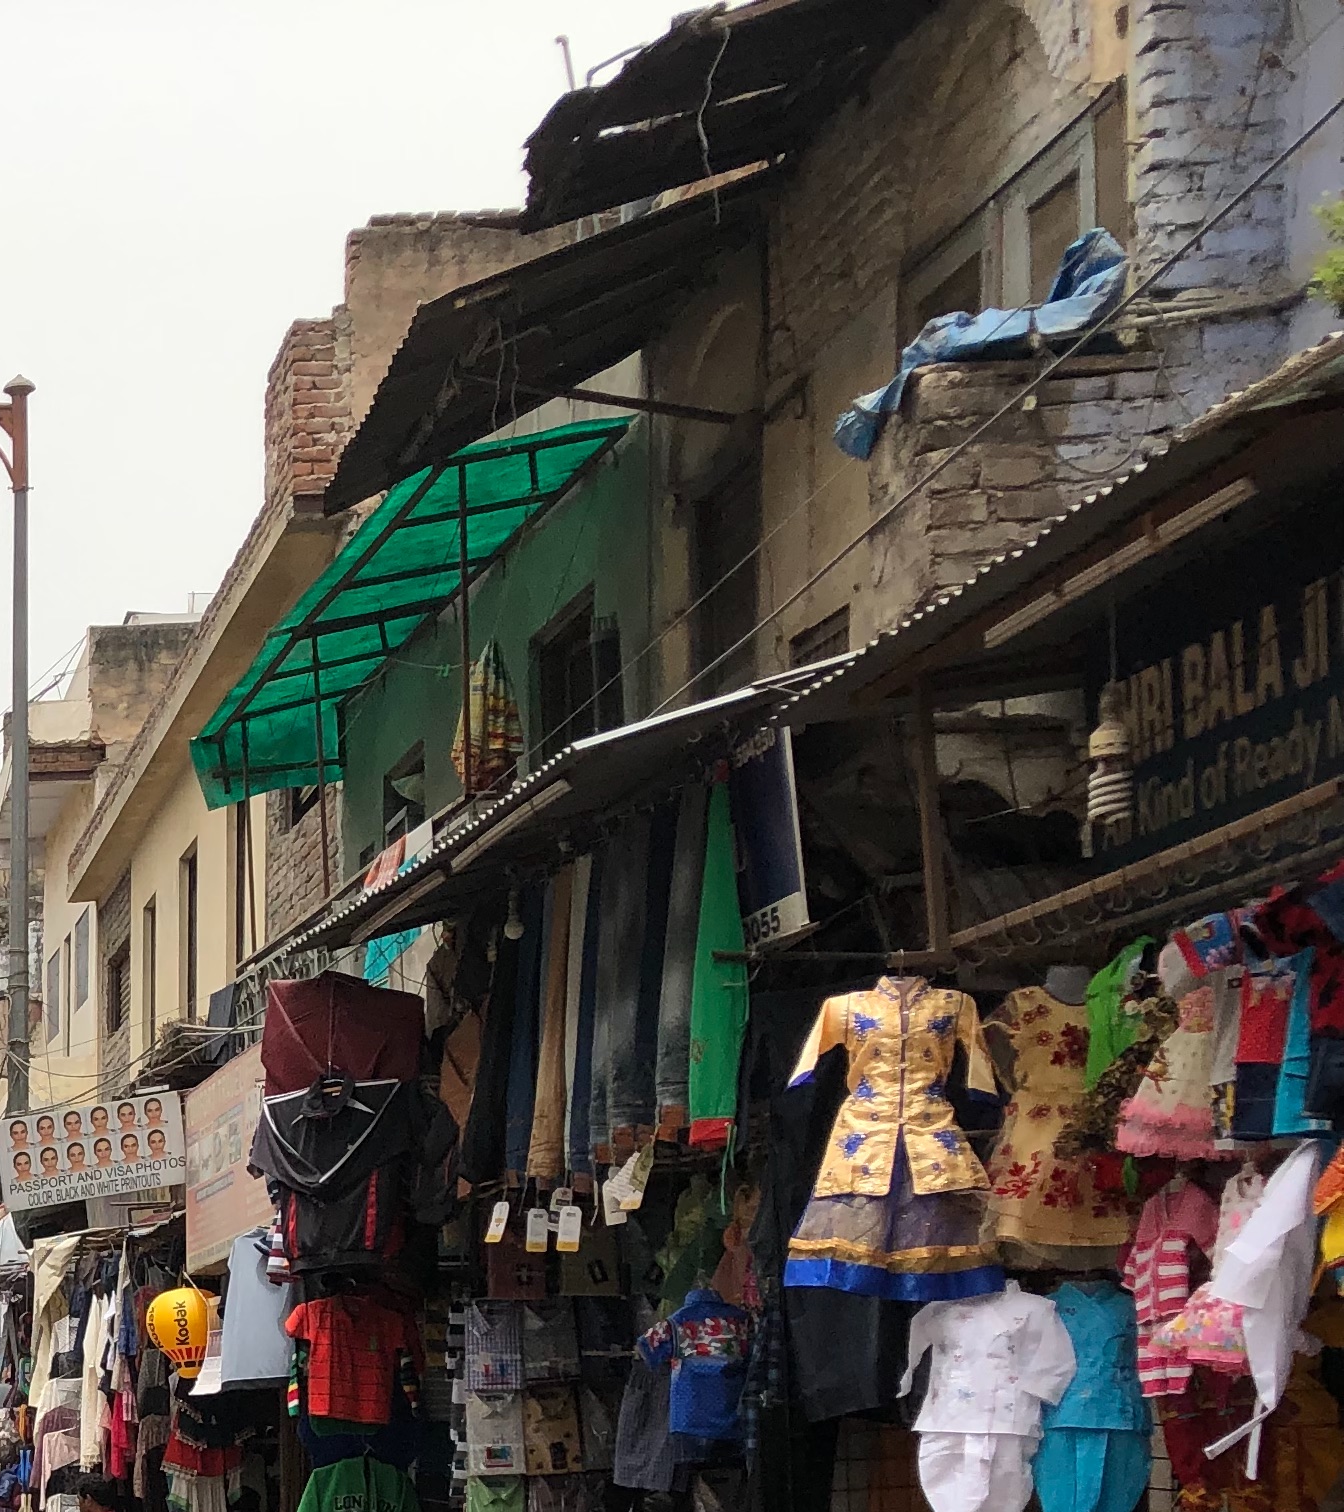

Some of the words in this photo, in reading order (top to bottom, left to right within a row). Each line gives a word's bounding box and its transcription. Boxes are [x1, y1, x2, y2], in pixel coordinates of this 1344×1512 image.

[1182, 604, 1285, 740] BALA
[1292, 577, 1330, 689] JI
[1199, 741, 1228, 810] of
[9, 1173, 74, 1196] PASSPORT
[76, 1169, 103, 1184] AND
[105, 1164, 134, 1179] VISA
[135, 1155, 187, 1174] PHOTOS
[56, 1186, 80, 1202] BLACK
[80, 1183, 96, 1198] AND
[96, 1178, 120, 1195] WHITE
[120, 1172, 162, 1191] PRINTOUTS
[172, 1300, 190, 1346] Kodak
